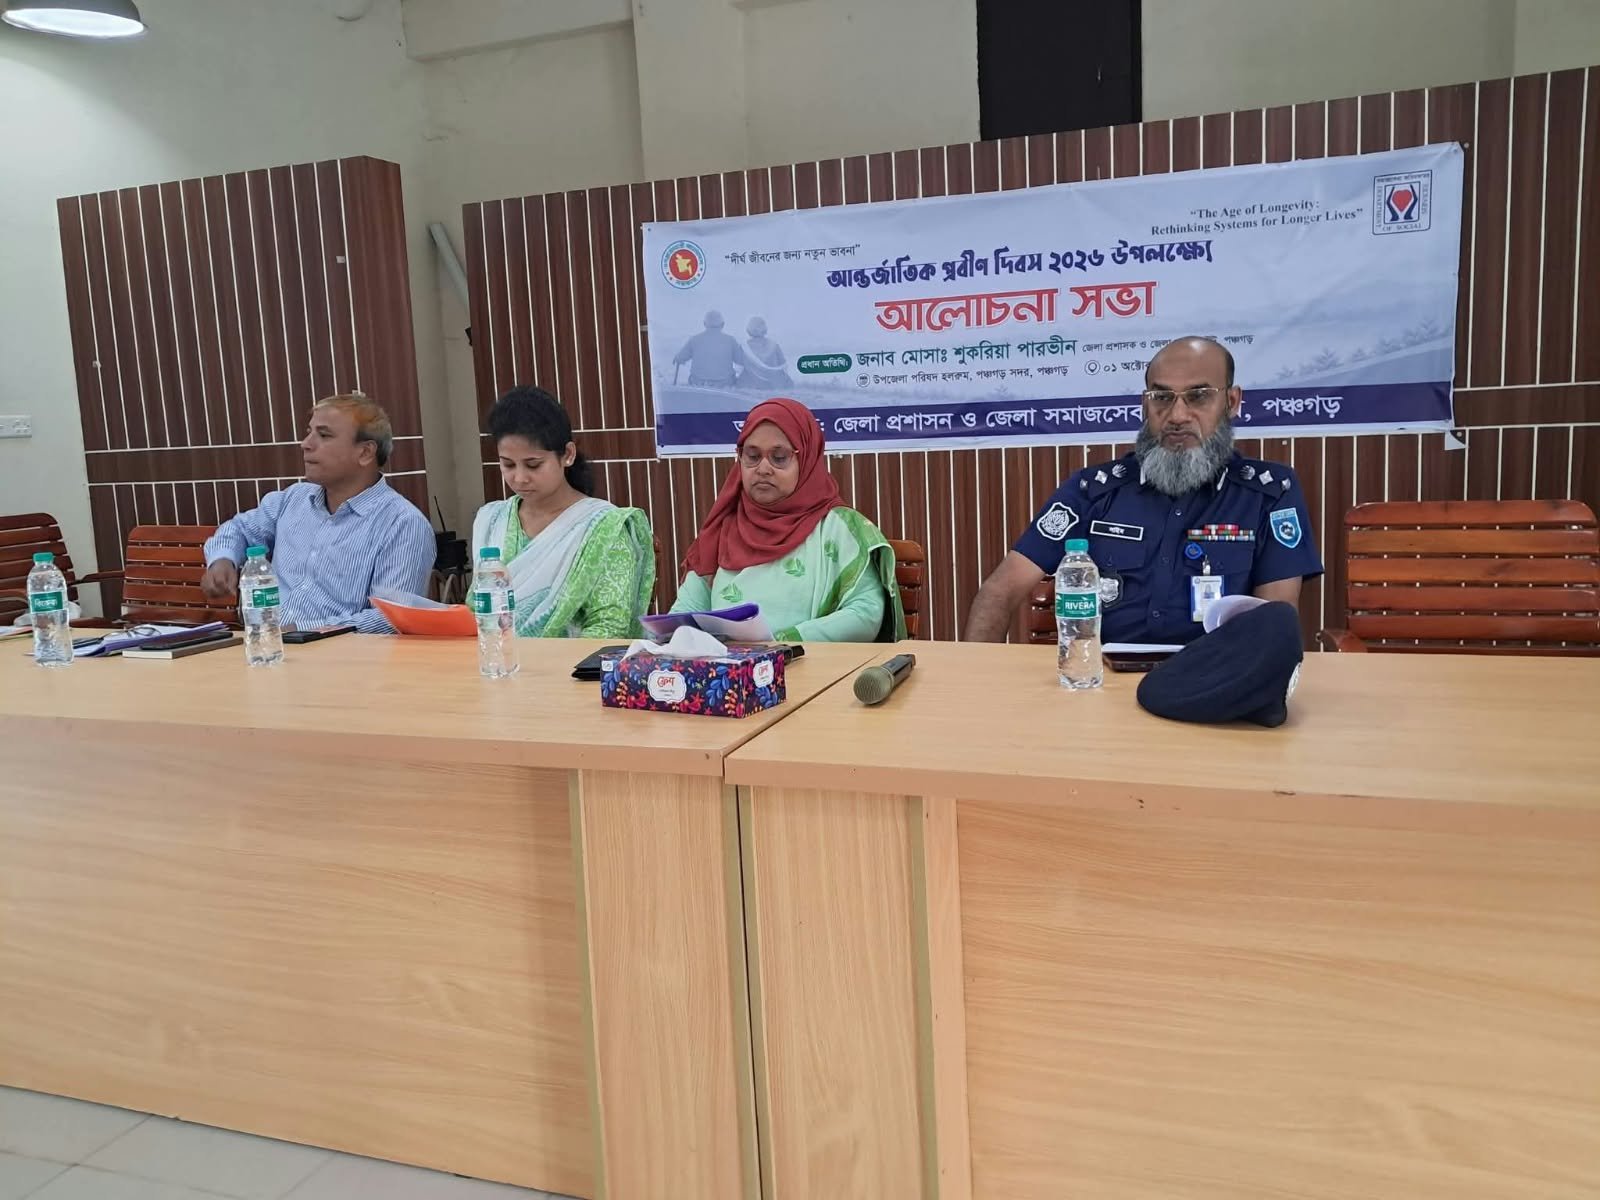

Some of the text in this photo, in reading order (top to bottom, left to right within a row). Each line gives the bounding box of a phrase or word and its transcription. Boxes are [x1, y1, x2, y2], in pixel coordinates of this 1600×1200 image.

[1220, 206, 1242, 218] Age
[1245, 204, 1256, 215] of
[1259, 200, 1320, 214] Longevity:
[1151, 222, 1211, 236] Rethinking
[1213, 219, 1258, 232] Systems
[1261, 216, 1278, 227] for
[1281, 213, 1321, 225] Longer
[749, 251, 780, 264] জীবনের
[783, 250, 801, 260] জন্য
[804, 248, 826, 261] নতুন
[826, 254, 937, 289] আন্তর্জাতিক
[942, 249, 989, 282] প্রবীণ
[994, 246, 1043, 275] দিবস
[1048, 249, 1105, 274] ২০২৬
[874, 281, 1157, 332] আলোচনা সভা
[856, 350, 896, 367] জনাব
[901, 347, 948, 365] মোসাঃ
[952, 340, 1011, 366] শুকরিয়া
[1017, 334, 1078, 358] পারভীন
[1082, 343, 1103, 352] জেলা
[1106, 341, 1138, 351] প্রশাসক
[1140, 341, 1147, 349] ও
[1224, 335, 1256, 345] পঞ্চগড়
[873, 373, 908, 385] উপজেলা
[911, 371, 938, 383] পরিষদ
[976, 368, 1006, 380] পঞ্চগড়
[1009, 367, 1033, 379] সদর,
[1037, 365, 1070, 377] পঞ্চগড়
[1103, 363, 1117, 373] ০১
[834, 413, 881, 433] জেলা
[885, 412, 954, 431] প্রশাসন
[960, 412, 977, 428] ও
[986, 408, 1037, 428] জেলা
[1042, 405, 1144, 425] সমাজসেব
[1262, 394, 1344, 419] পঞ্চগড়
[1065, 601, 1095, 610] RIVERA
